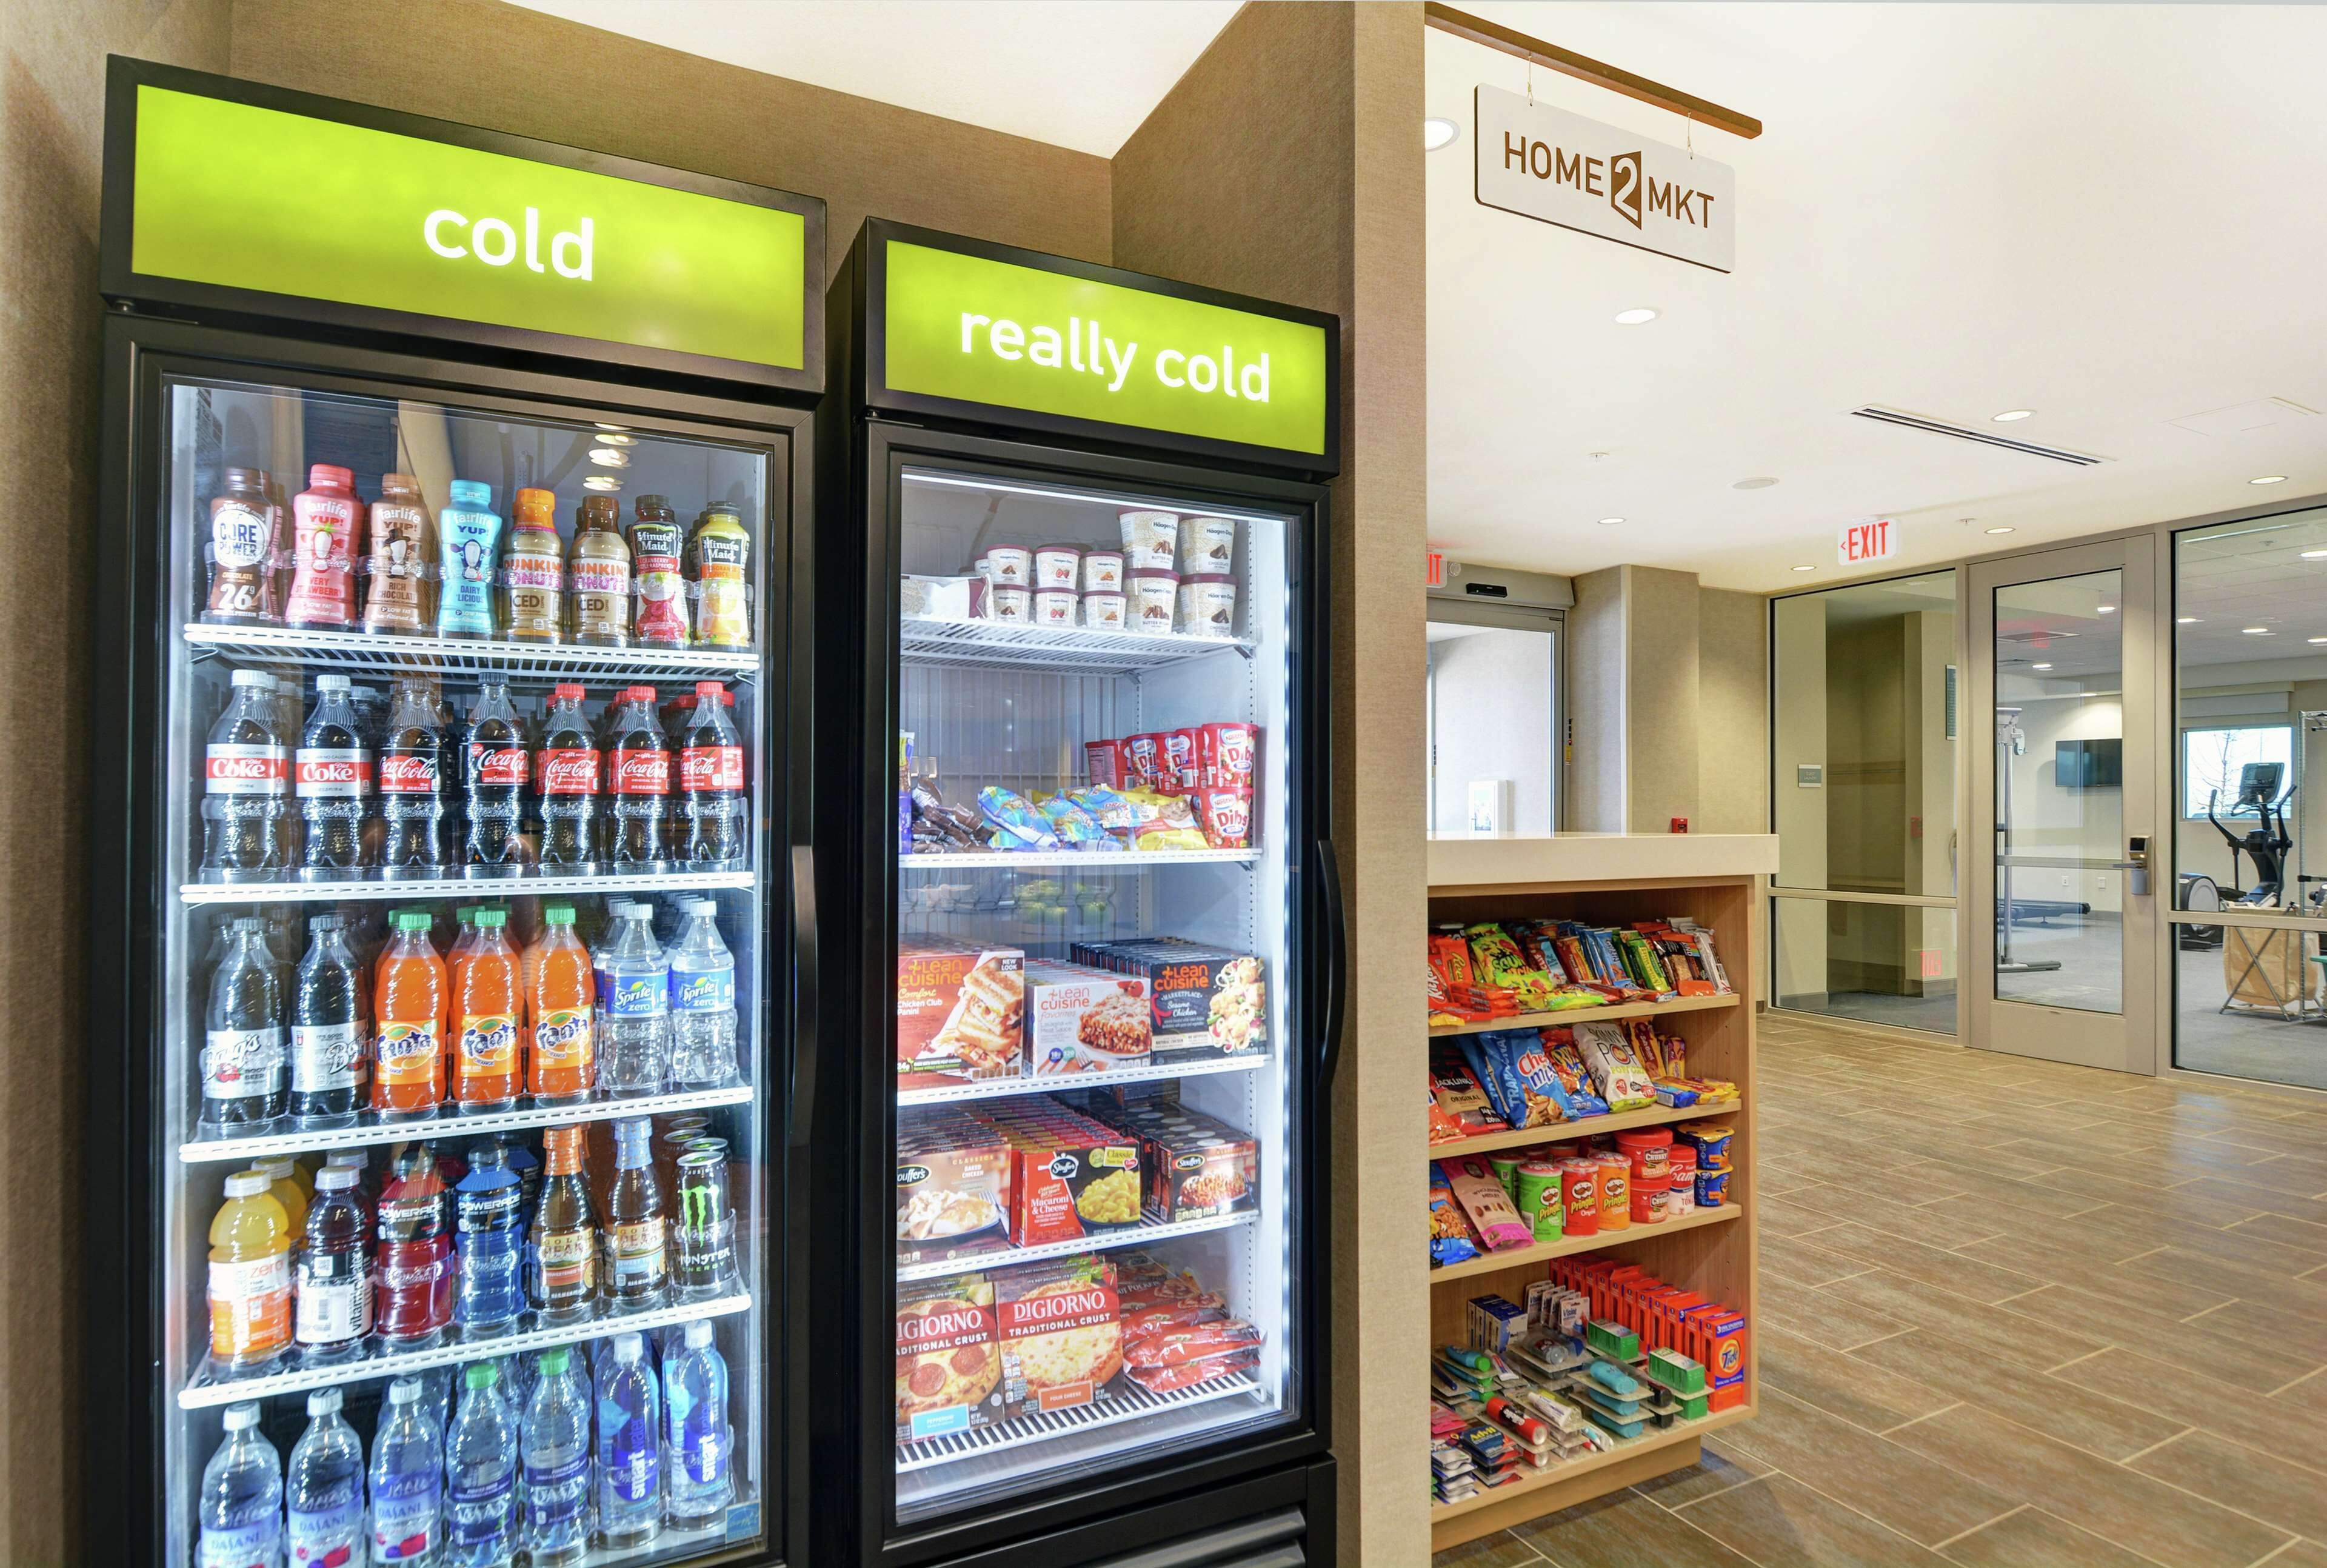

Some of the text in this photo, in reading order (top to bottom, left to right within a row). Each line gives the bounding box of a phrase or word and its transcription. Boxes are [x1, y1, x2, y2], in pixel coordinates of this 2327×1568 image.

[424, 207, 595, 281] cold
[961, 312, 1270, 403] really cold
[309, 515, 344, 527] YUP!
[377, 508, 421, 524] fairlife
[383, 521, 418, 532] YUP!
[458, 525, 489, 536] YUP!
[636, 531, 675, 542] Minute
[1848, 521, 1889, 561] EXIT
[642, 541, 669, 552] Maid
[703, 538, 739, 552] Minute
[709, 549, 736, 562] Maid
[309, 576, 330, 585] VERY
[389, 582, 406, 591] RICH
[461, 585, 481, 595] DAIRY
[510, 595, 540, 608] ICED
[576, 598, 604, 612] ICED
[212, 759, 265, 778] Coke
[302, 762, 354, 782] Coke
[546, 758, 598, 777] Coca-Cola
[621, 758, 669, 779] Coca-Cola
[1217, 809, 1248, 828] Dibs
[921, 959, 963, 974] Lean
[1492, 955, 1524, 971] SOUR
[1175, 964, 1208, 978] Lean
[616, 987, 651, 1006] Sprite
[684, 983, 715, 1001] Sprite
[898, 987, 937, 999] Comfort
[1058, 987, 1090, 999] Lean
[1162, 990, 1201, 1001] MARKETPLACE
[1167, 1001, 1190, 1010] Sesame
[1172, 1008, 1198, 1018] Chicken
[461, 1024, 516, 1056] Fanta
[377, 1031, 432, 1064] Fanta
[1597, 1042, 1638, 1066] POP
[1610, 1066, 1645, 1074] POPCORN
[1435, 1078, 1454, 1089] JACK
[952, 1154, 995, 1165] CLASSICS
[1106, 1149, 1133, 1158] Classic
[1644, 1153, 1668, 1162] CHUNKY
[961, 1170, 984, 1178] CHICKEN
[458, 1193, 521, 1211] POWERADE
[1031, 1194, 1069, 1207] Macaroni
[1571, 1195, 1596, 1215] Pringles
[1603, 1193, 1628, 1212] Pringles
[378, 1202, 444, 1218] POWERADE
[1032, 1203, 1068, 1215] & Cheese
[250, 1259, 284, 1279] zero
[1013, 1290, 1106, 1323] DIGIORNO
[896, 1309, 983, 1341] IGIORNO
[1009, 1312, 1111, 1337] TRADITIONAL CRUST
[955, 1332, 988, 1346] CRUST
[1470, 1426, 1497, 1442] Advil
[378, 1502, 421, 1516] DASANI
[299, 1515, 345, 1532] DASANI
